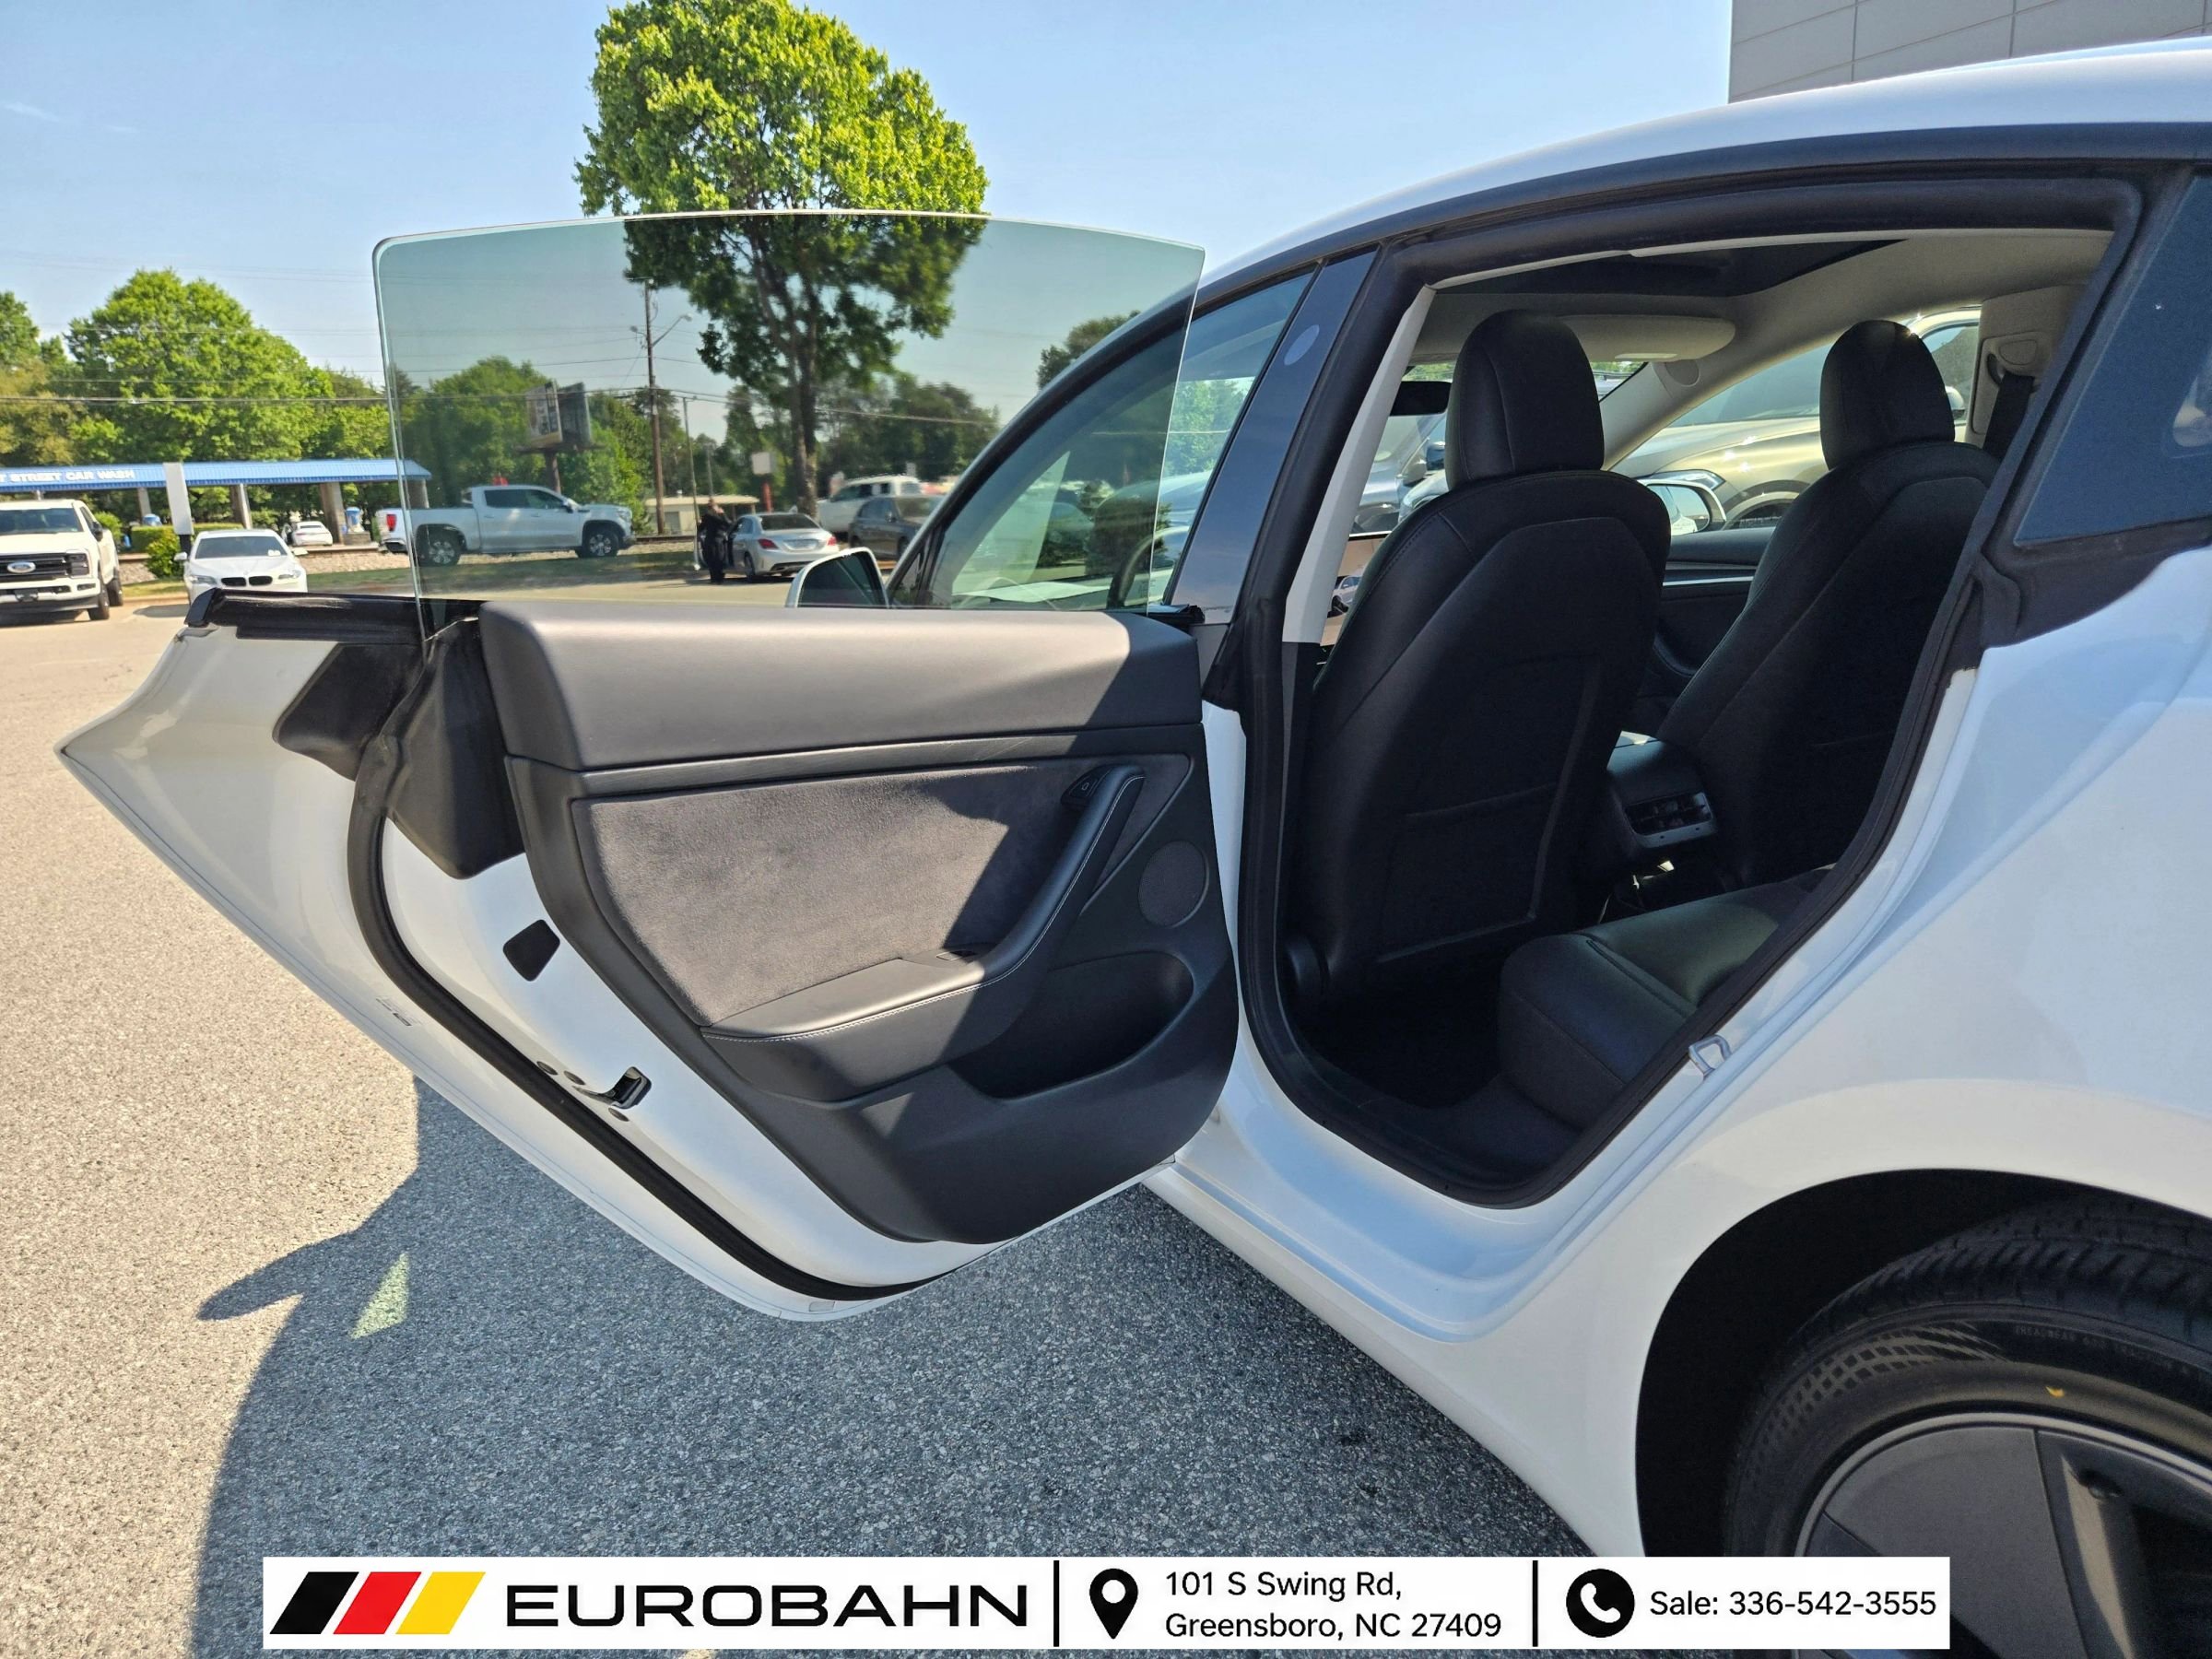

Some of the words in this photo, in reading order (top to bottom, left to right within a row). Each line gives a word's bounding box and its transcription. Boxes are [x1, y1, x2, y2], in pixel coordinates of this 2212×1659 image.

[9, 472, 62, 483] STREET
[65, 471, 94, 480] CAR
[97, 469, 135, 479] WASH
